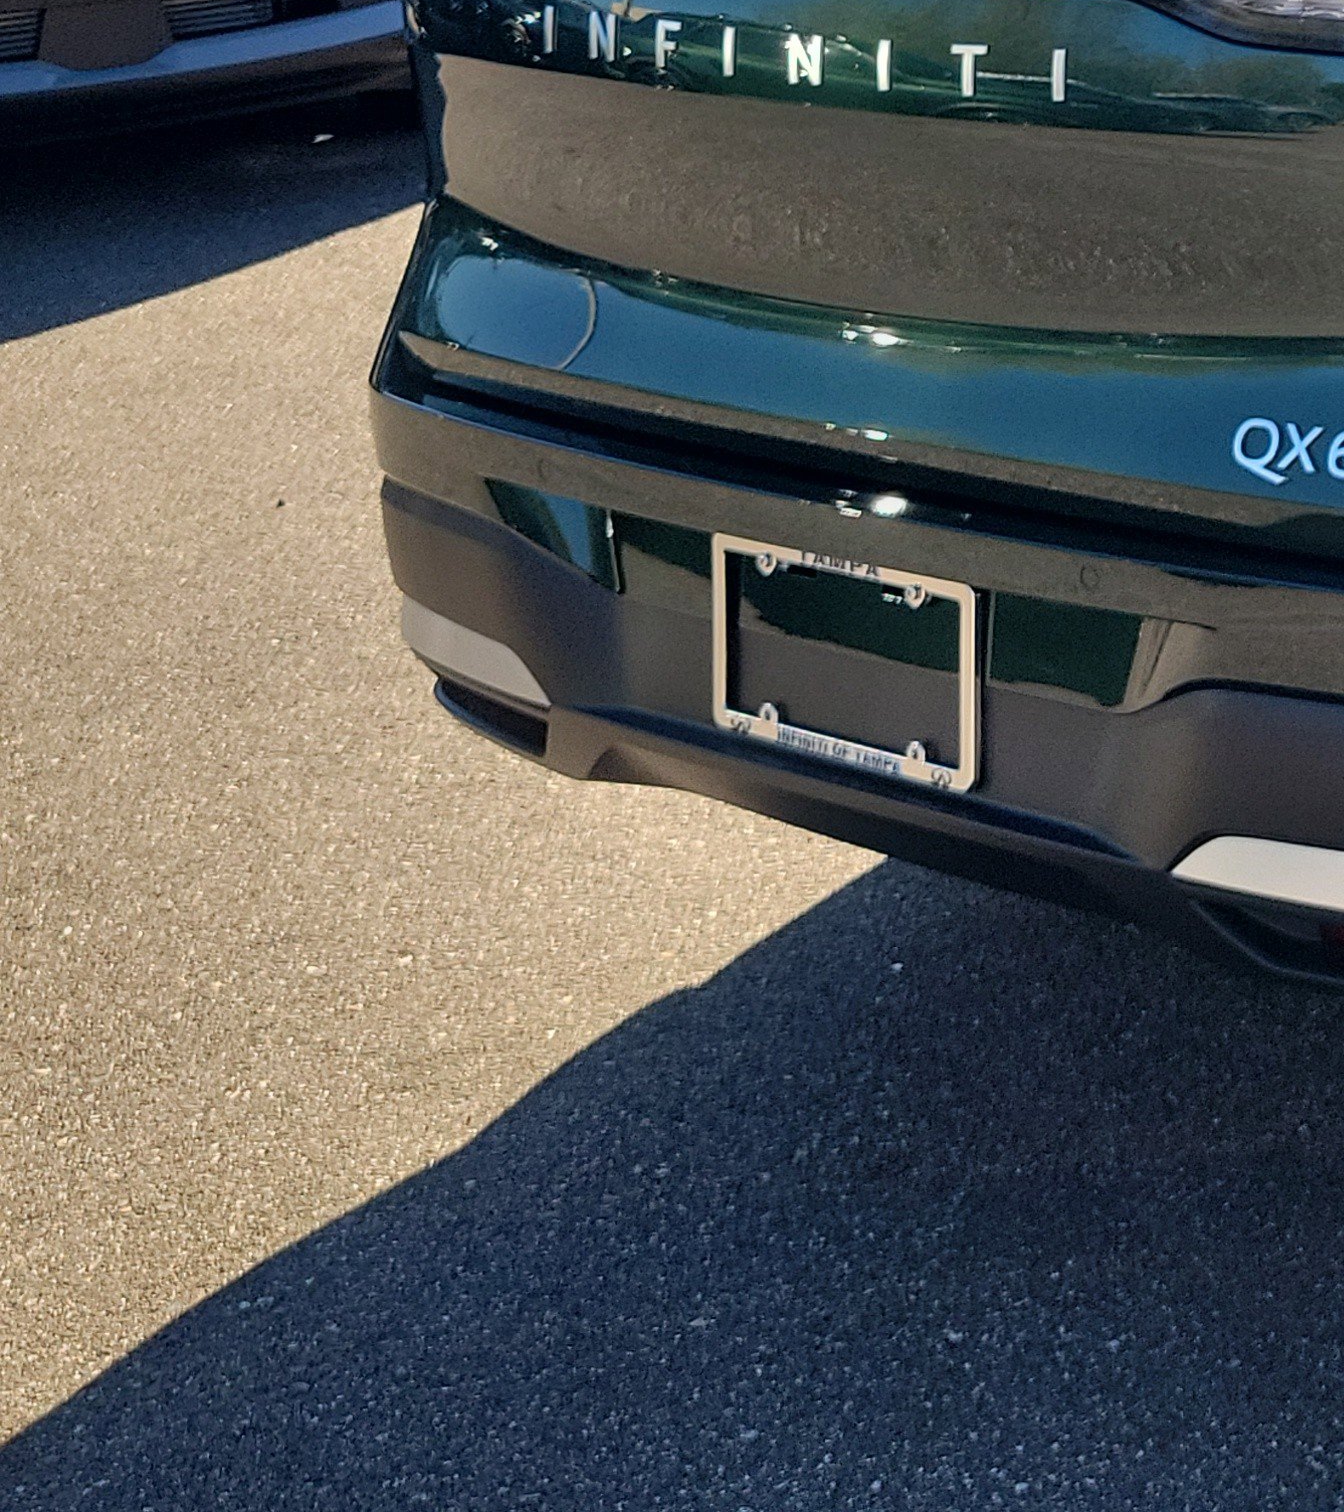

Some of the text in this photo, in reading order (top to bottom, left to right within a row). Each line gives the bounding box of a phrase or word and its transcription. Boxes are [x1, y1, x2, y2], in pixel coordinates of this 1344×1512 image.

[542, 4, 1068, 103] INFINITI
[800, 550, 879, 576] TAMPA
[832, 741, 849, 759] OF
